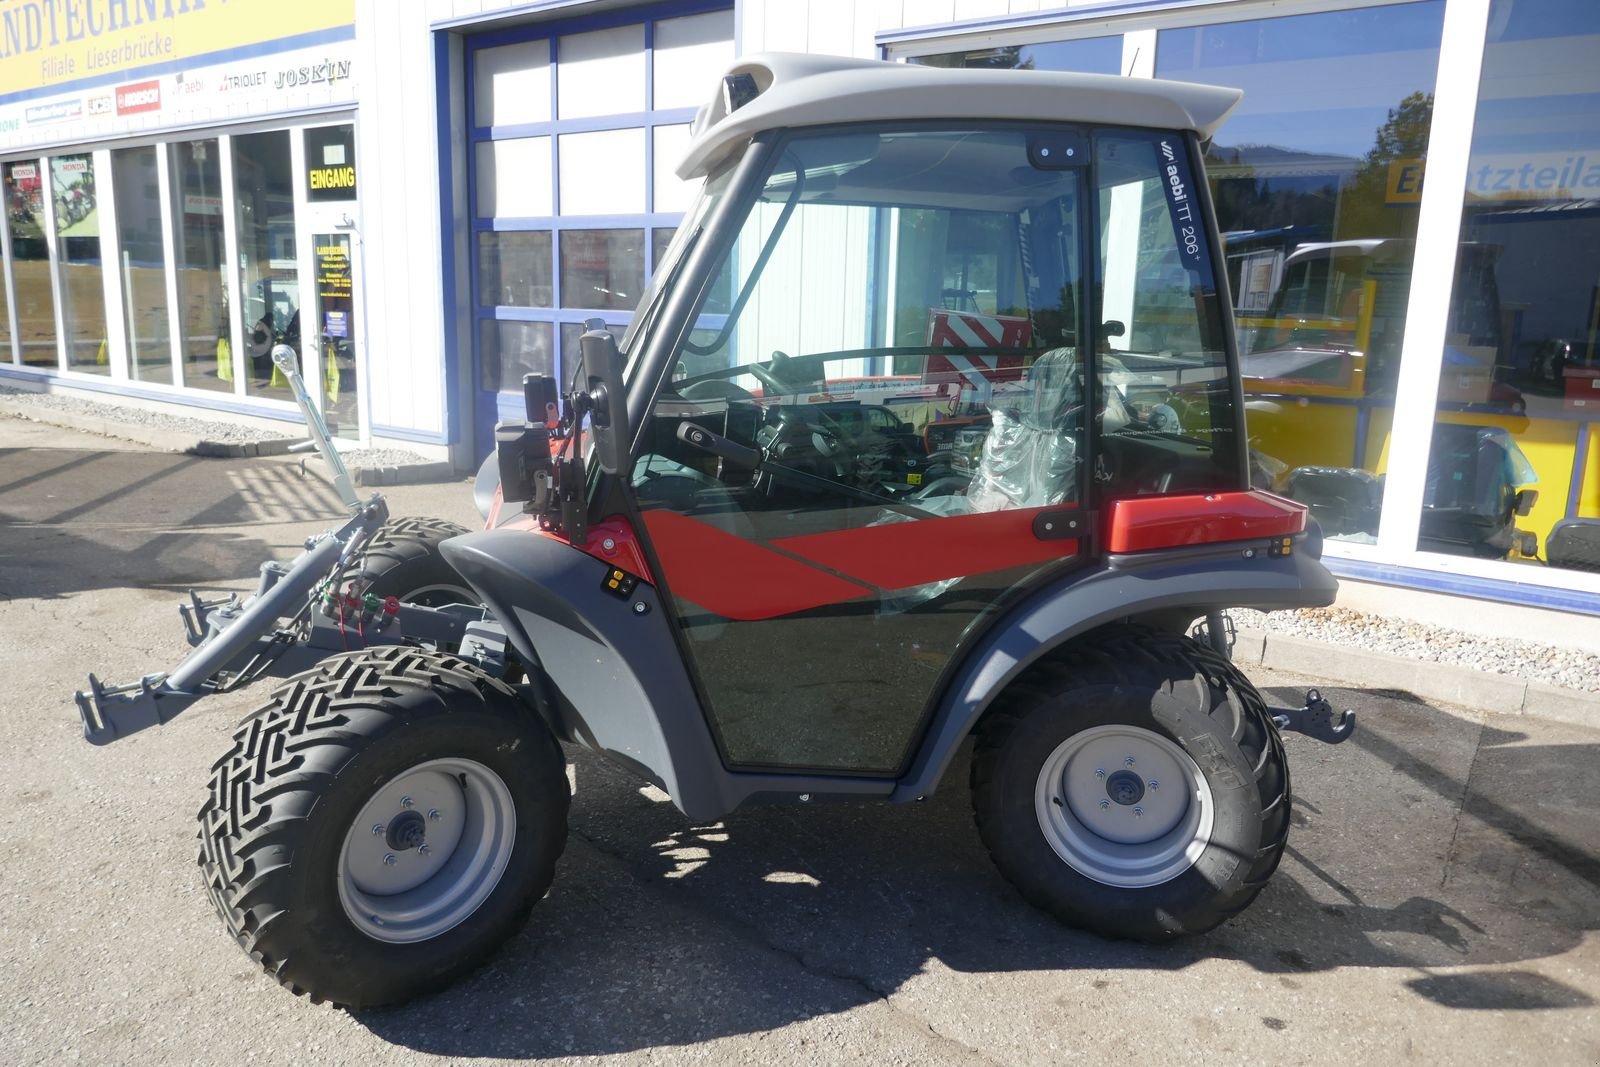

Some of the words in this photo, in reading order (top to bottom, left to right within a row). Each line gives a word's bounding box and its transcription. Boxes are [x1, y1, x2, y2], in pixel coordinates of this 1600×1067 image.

[41, 53, 75, 79] Filiale
[86, 31, 173, 70] Lieserbrücke
[13, 169, 34, 177] HONDA
[63, 163, 86, 171] HONDA
[310, 167, 355, 189] EINGANG
[1166, 164, 1187, 202] aebi
[1177, 203, 1192, 222] TT
